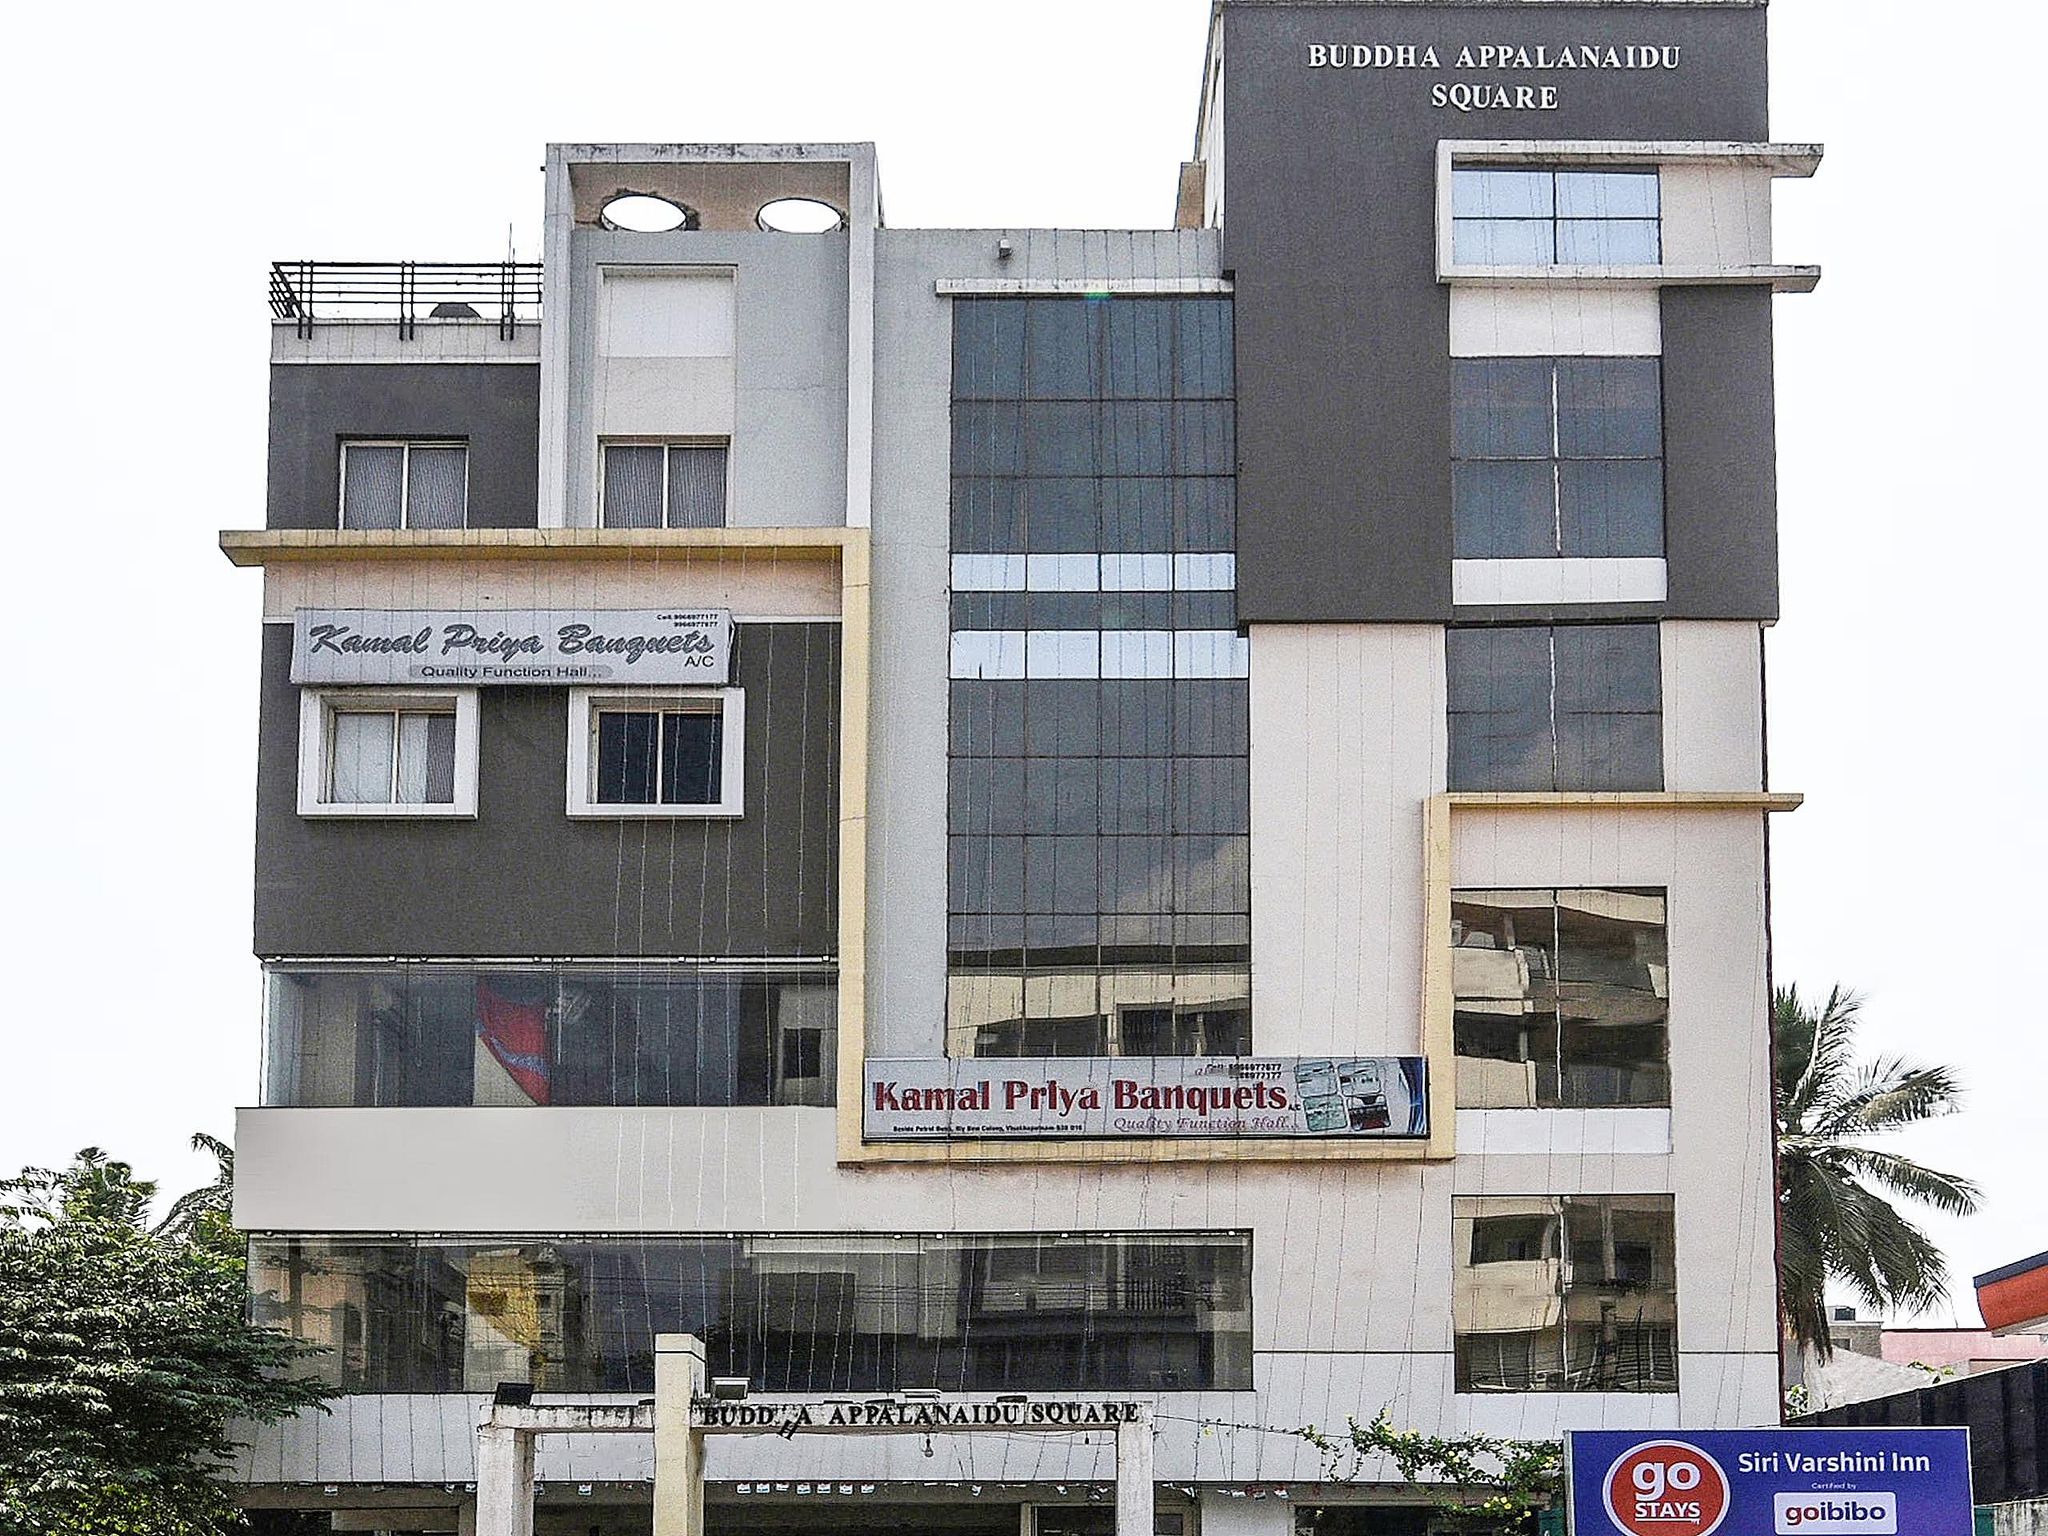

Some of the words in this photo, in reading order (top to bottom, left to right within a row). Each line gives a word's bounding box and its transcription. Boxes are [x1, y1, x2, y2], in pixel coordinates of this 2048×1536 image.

[1308, 44, 1441, 69] BUDDHA
[1455, 45, 1681, 69] APPALANAIDU
[1431, 83, 1558, 110] SQUARE
[309, 623, 429, 655] Kamal
[441, 623, 545, 662] Priya
[558, 622, 714, 665] Banquets
[421, 666, 477, 679] Quality
[483, 666, 550, 677] Function
[684, 655, 714, 667] A/C
[873, 1080, 991, 1111] Kamal
[1003, 1080, 1101, 1117] Priya
[1113, 1117, 1172, 1132] Quality
[1177, 1117, 1246, 1130] Function
[703, 1405, 813, 1440] BUDDHA
[829, 1404, 1020, 1425] APPALANAIDU
[1031, 1403, 1138, 1423] SQUARE
[1738, 1452, 1778, 1472] Siri
[1784, 1452, 1887, 1472] Varshini
[1892, 1452, 1930, 1472] Inn
[1632, 1461, 1700, 1500] go
[1635, 1502, 1700, 1518] STAYS
[1786, 1502, 1886, 1525] goibibo
